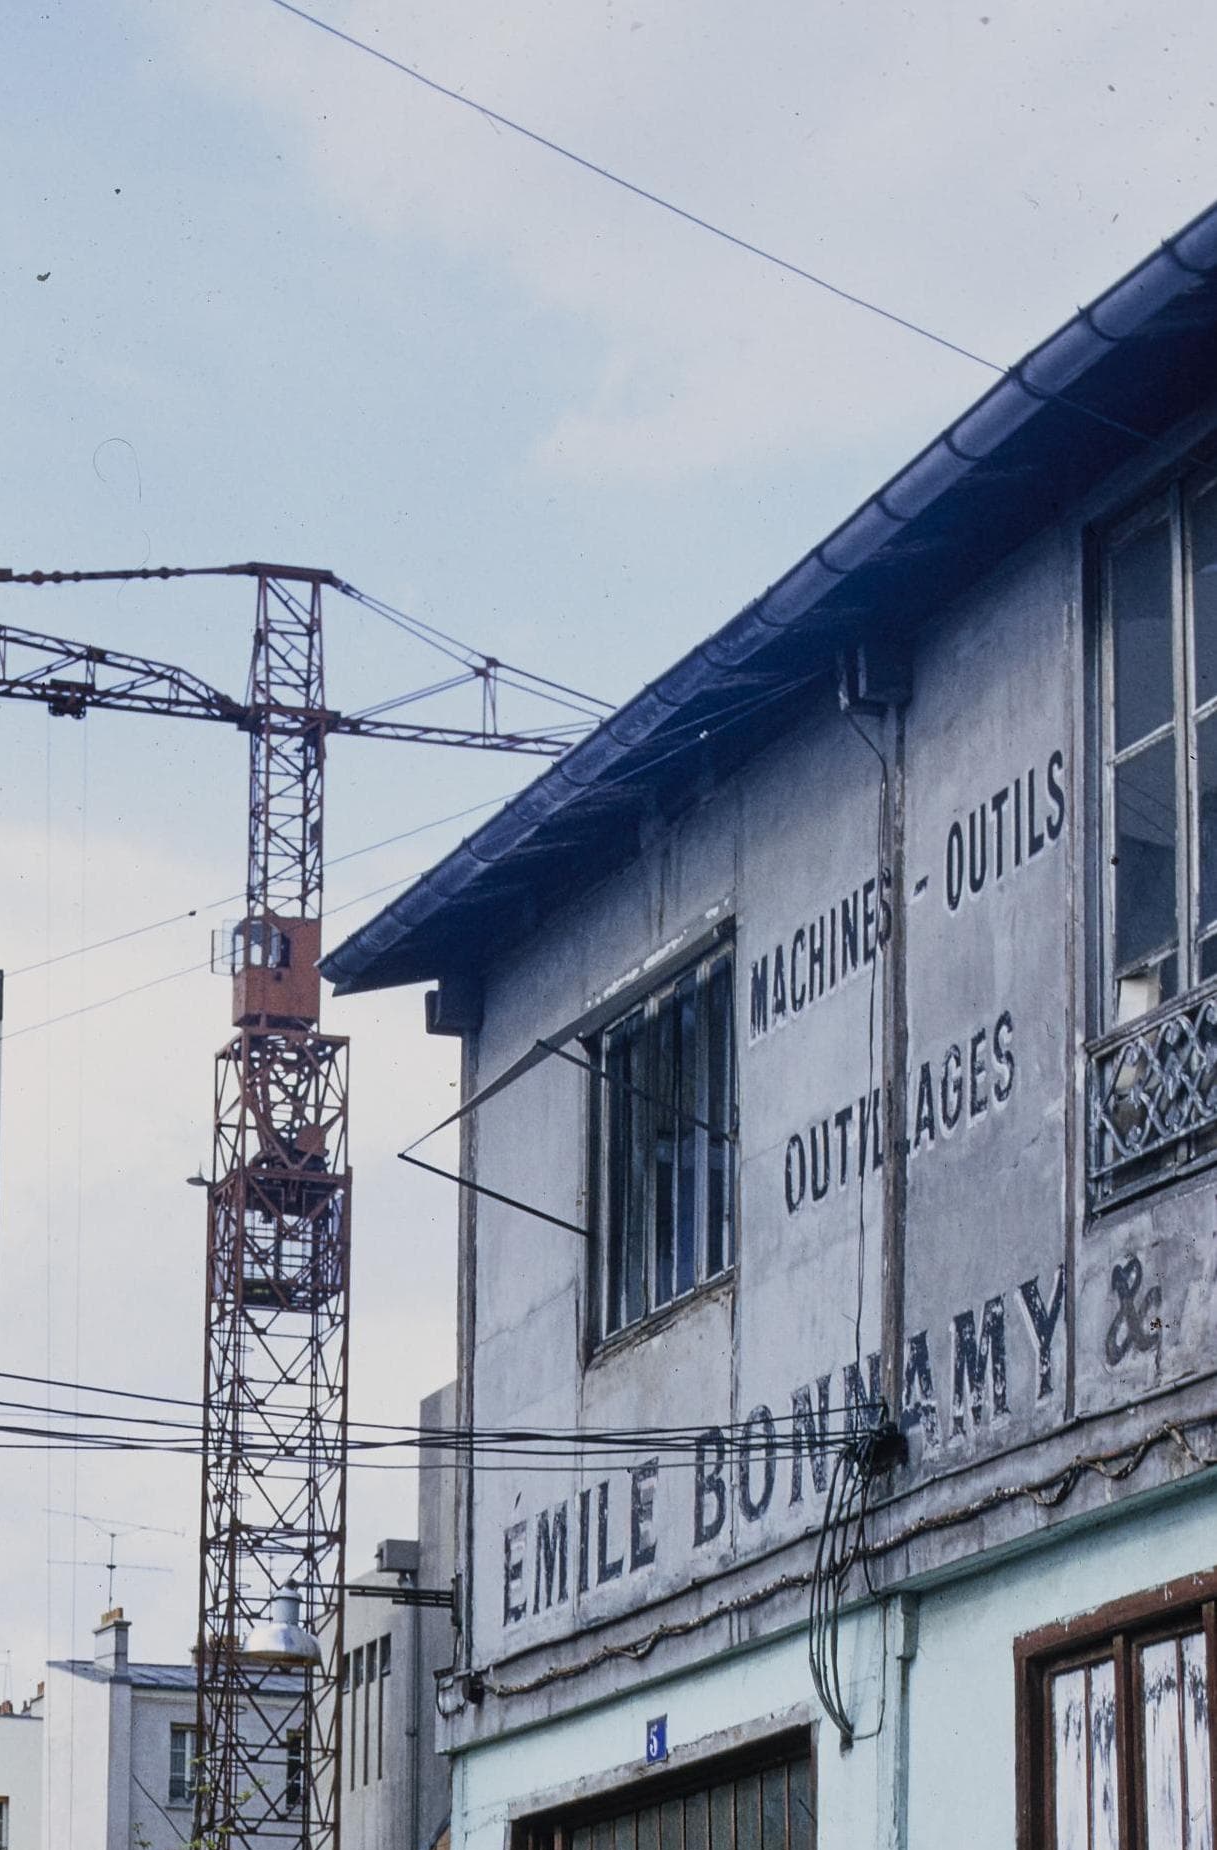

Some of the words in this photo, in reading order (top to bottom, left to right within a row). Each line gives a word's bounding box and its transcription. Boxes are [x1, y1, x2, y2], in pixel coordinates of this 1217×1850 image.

[749, 867, 892, 1040] MACHINES
[946, 750, 1066, 911] OUTILS
[1104, 1256, 1163, 1367] &
[649, 1724, 658, 1757] 5
